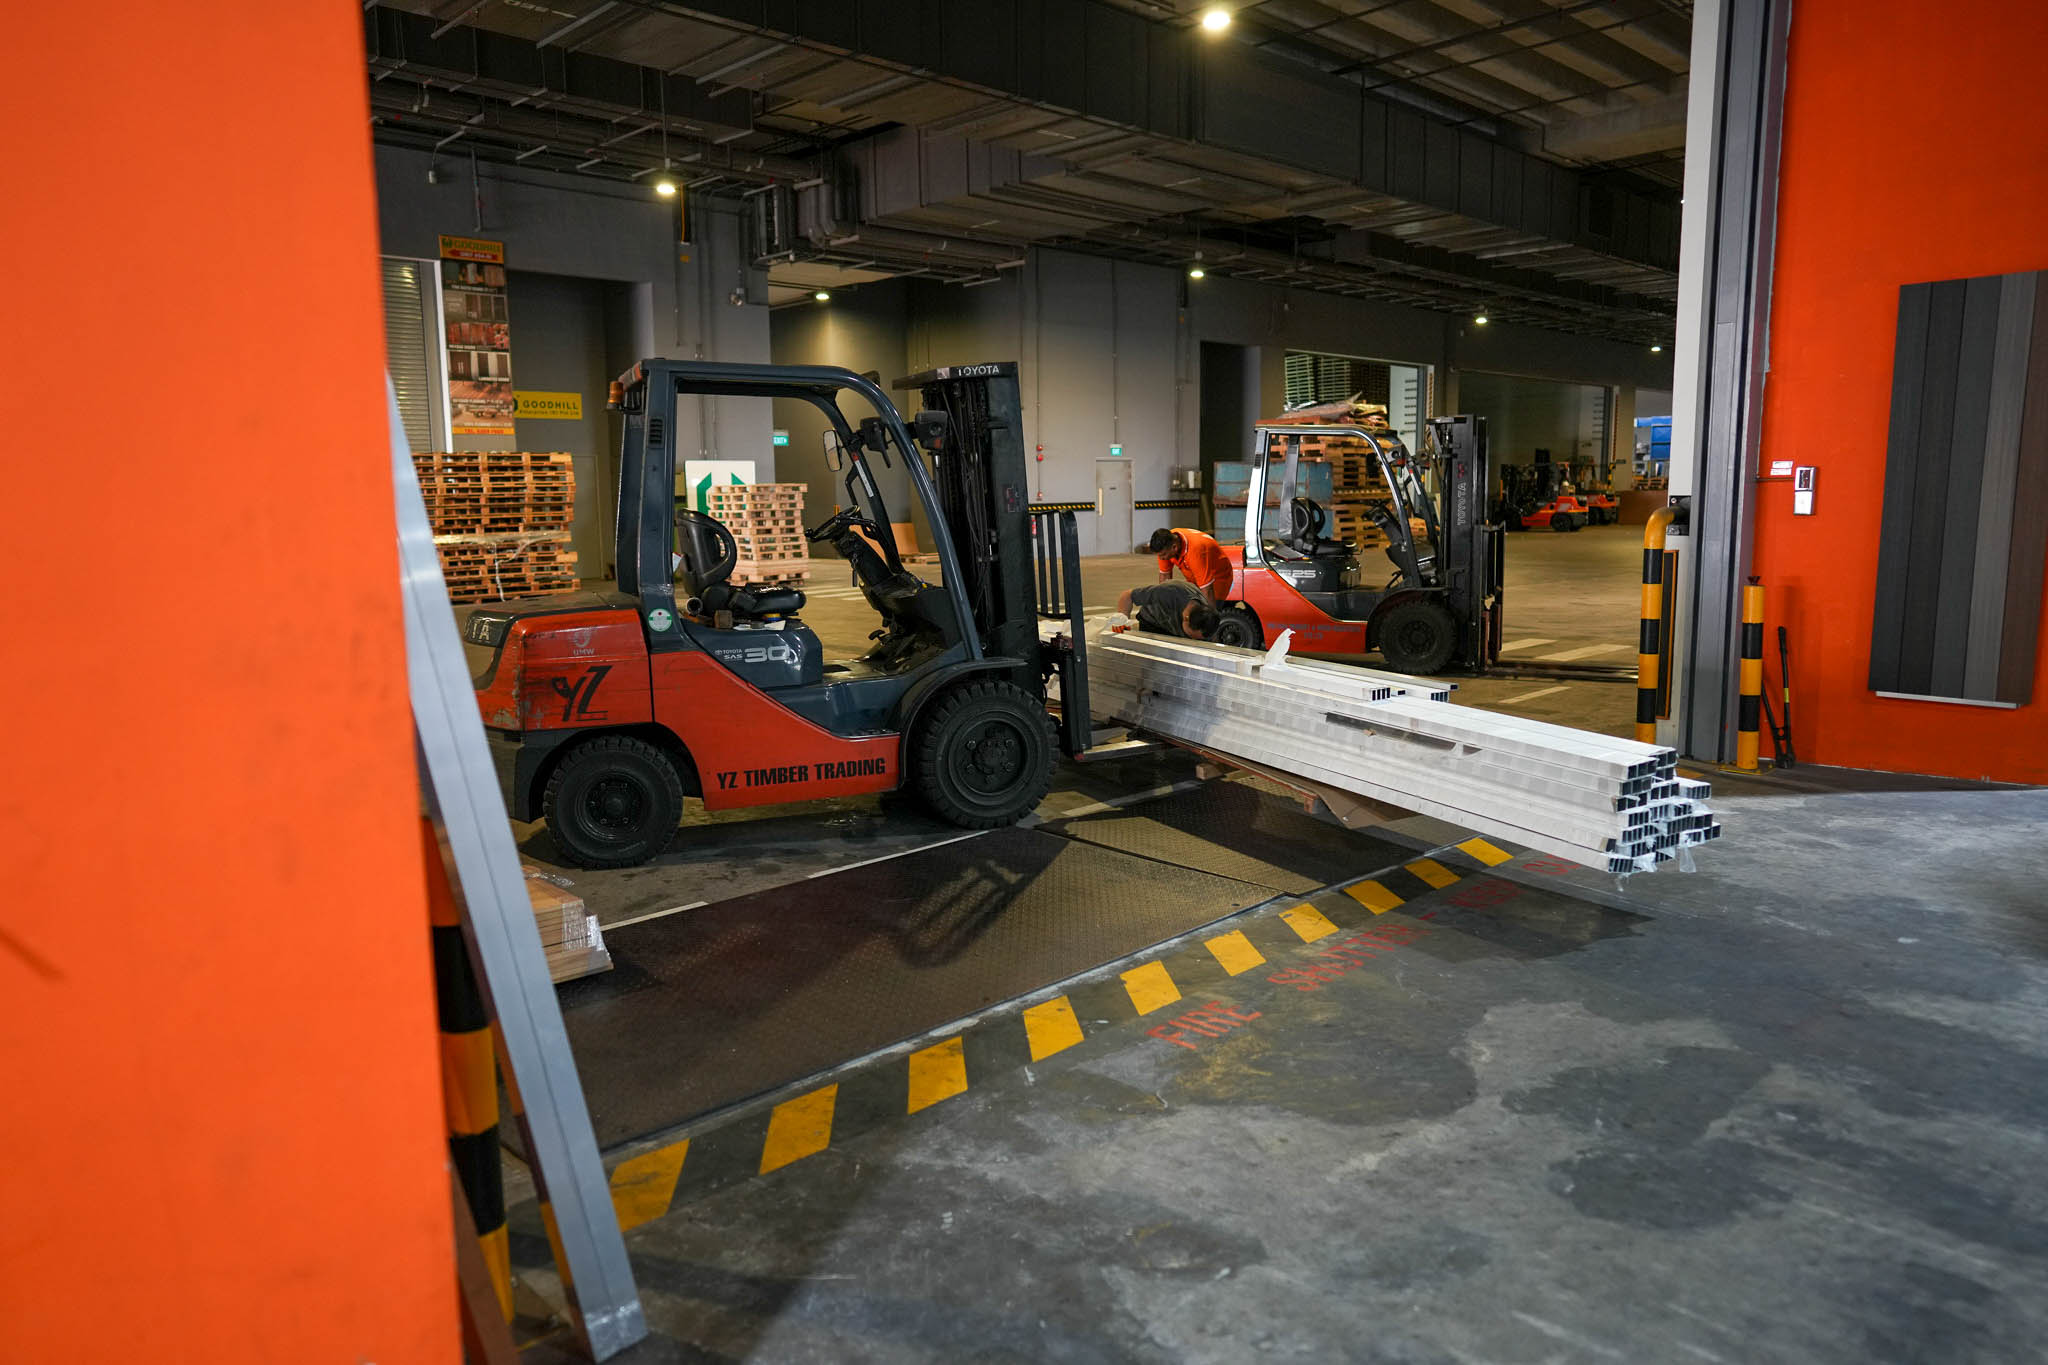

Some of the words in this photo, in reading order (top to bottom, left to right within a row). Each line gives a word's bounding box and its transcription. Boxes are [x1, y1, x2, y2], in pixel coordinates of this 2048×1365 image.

[523, 400, 579, 410] GOODHILL
[1457, 482, 1467, 526] TOYOTA
[1292, 569, 1317, 579] 25
[573, 648, 595, 656] UMW
[744, 646, 790, 663] 30
[717, 771, 738, 790] YZ
[744, 765, 809, 788] TIMBER
[813, 757, 886, 781] TRADING
[1145, 1000, 1262, 1050] FIRE
[1267, 924, 1428, 991] SHUTTER
